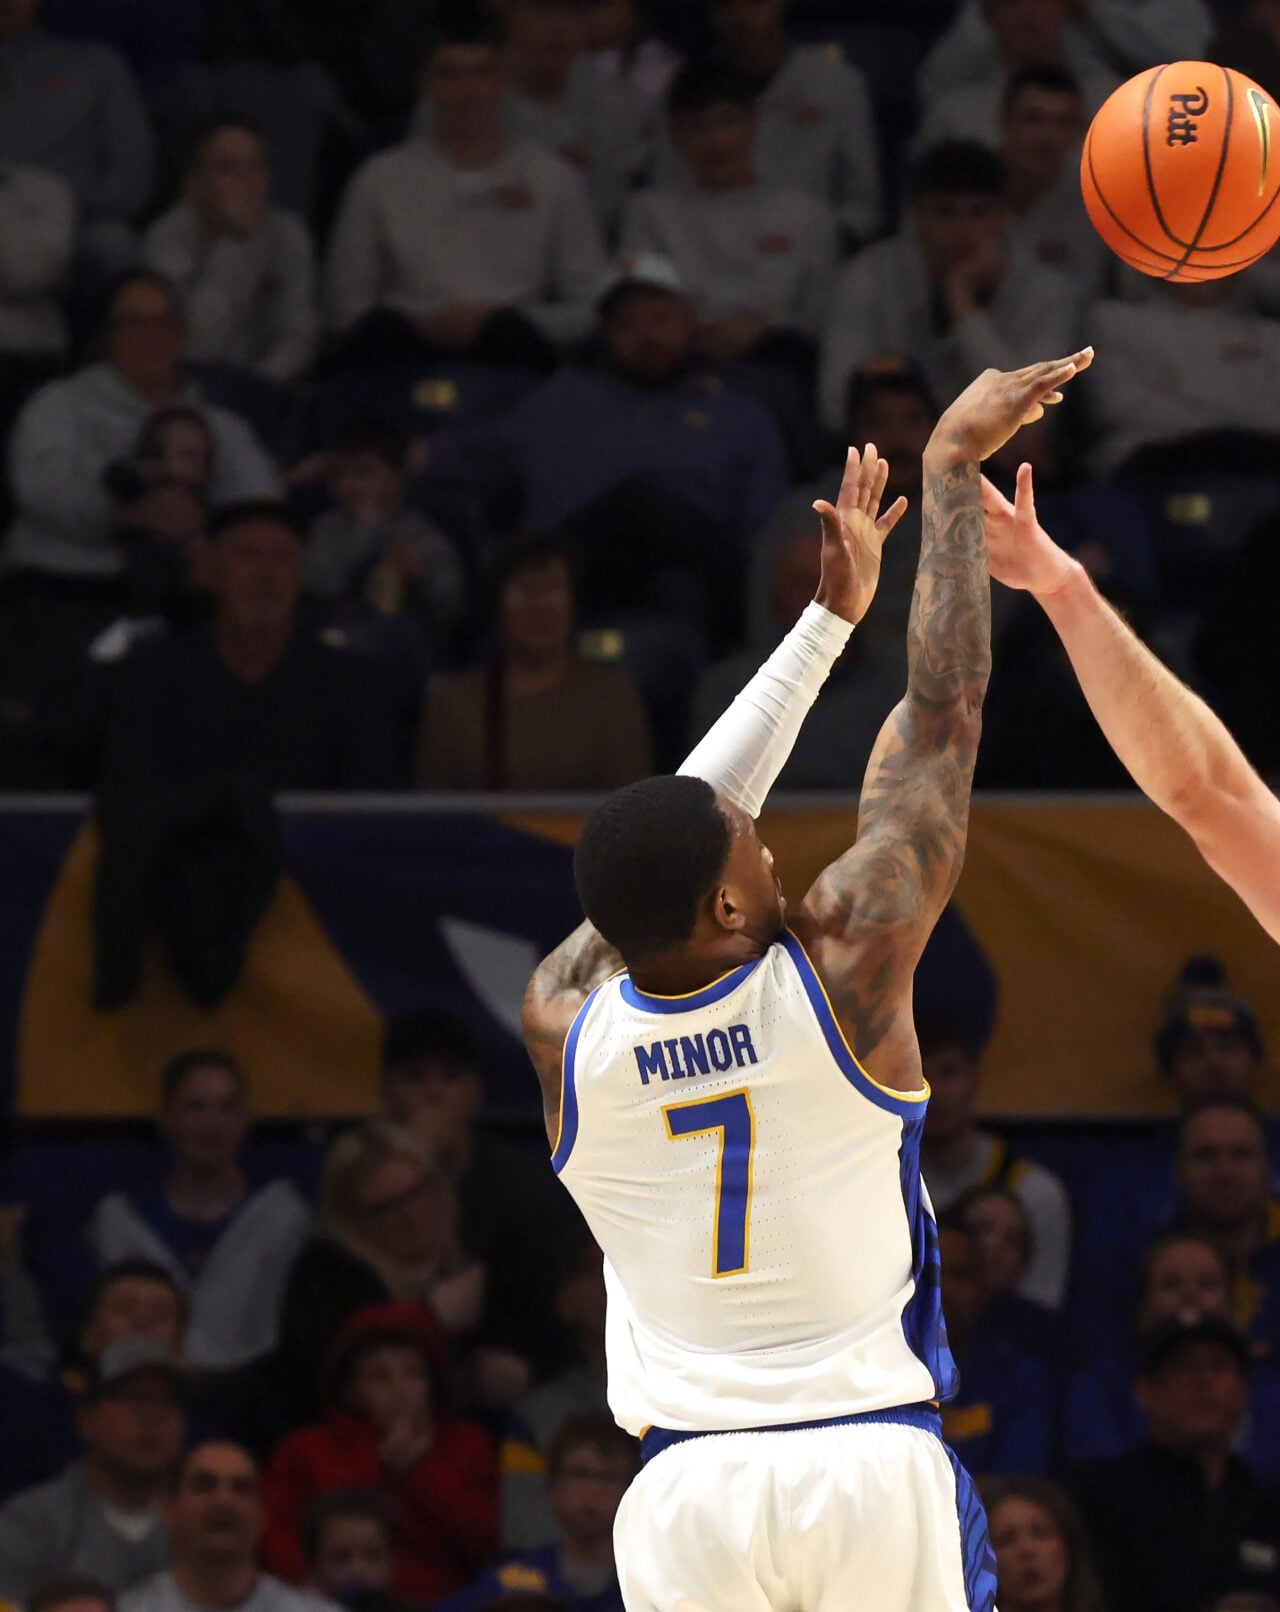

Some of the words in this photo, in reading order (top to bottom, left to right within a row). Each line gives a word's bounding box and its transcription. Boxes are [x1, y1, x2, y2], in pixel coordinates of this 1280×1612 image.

[1167, 86, 1209, 147] Pitt
[634, 1023, 759, 1085] MINOR
[660, 1086, 756, 1280] 7
